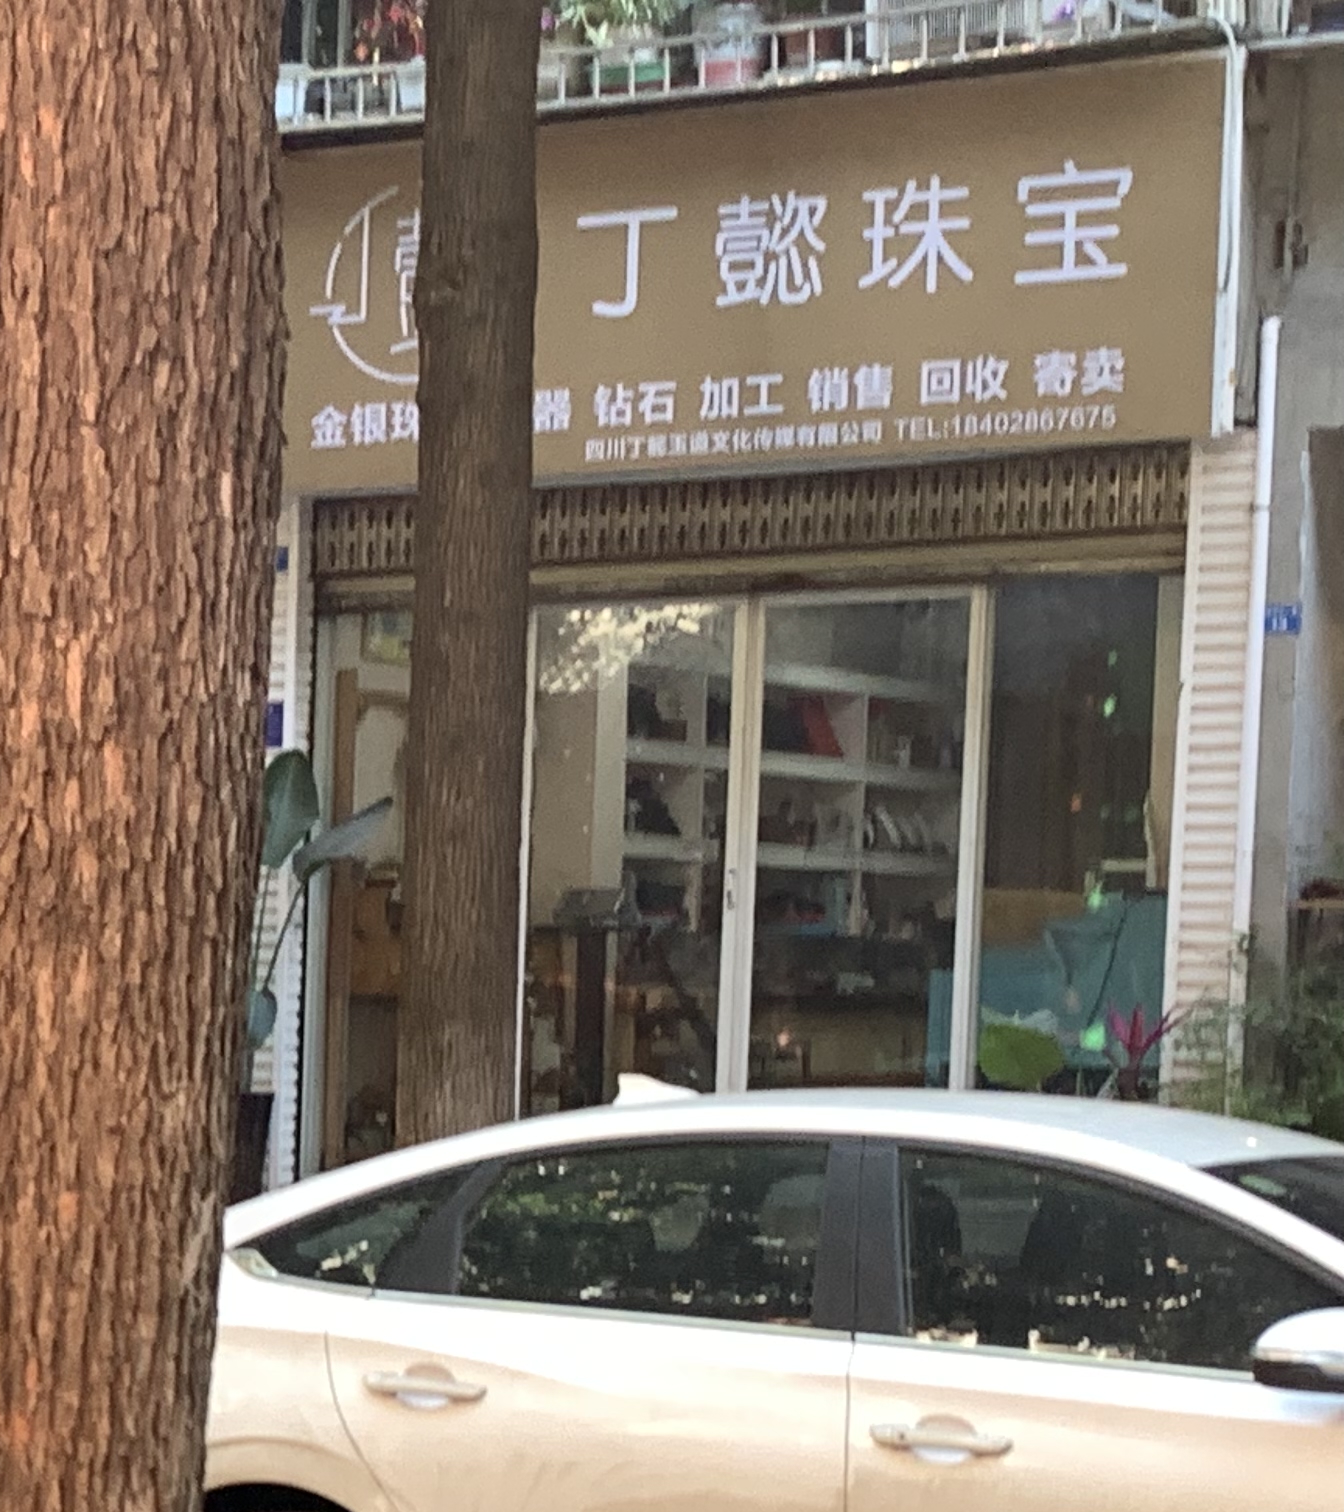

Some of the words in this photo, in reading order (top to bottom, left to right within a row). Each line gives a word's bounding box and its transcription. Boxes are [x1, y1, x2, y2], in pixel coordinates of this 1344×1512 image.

[576, 158, 1133, 318] 丁懿珠宝
[594, 380, 677, 427] 钻石
[700, 374, 784, 421] 加工
[807, 363, 894, 414] 销售
[919, 354, 1009, 404] 回收
[1032, 345, 1126, 397] 寄卖
